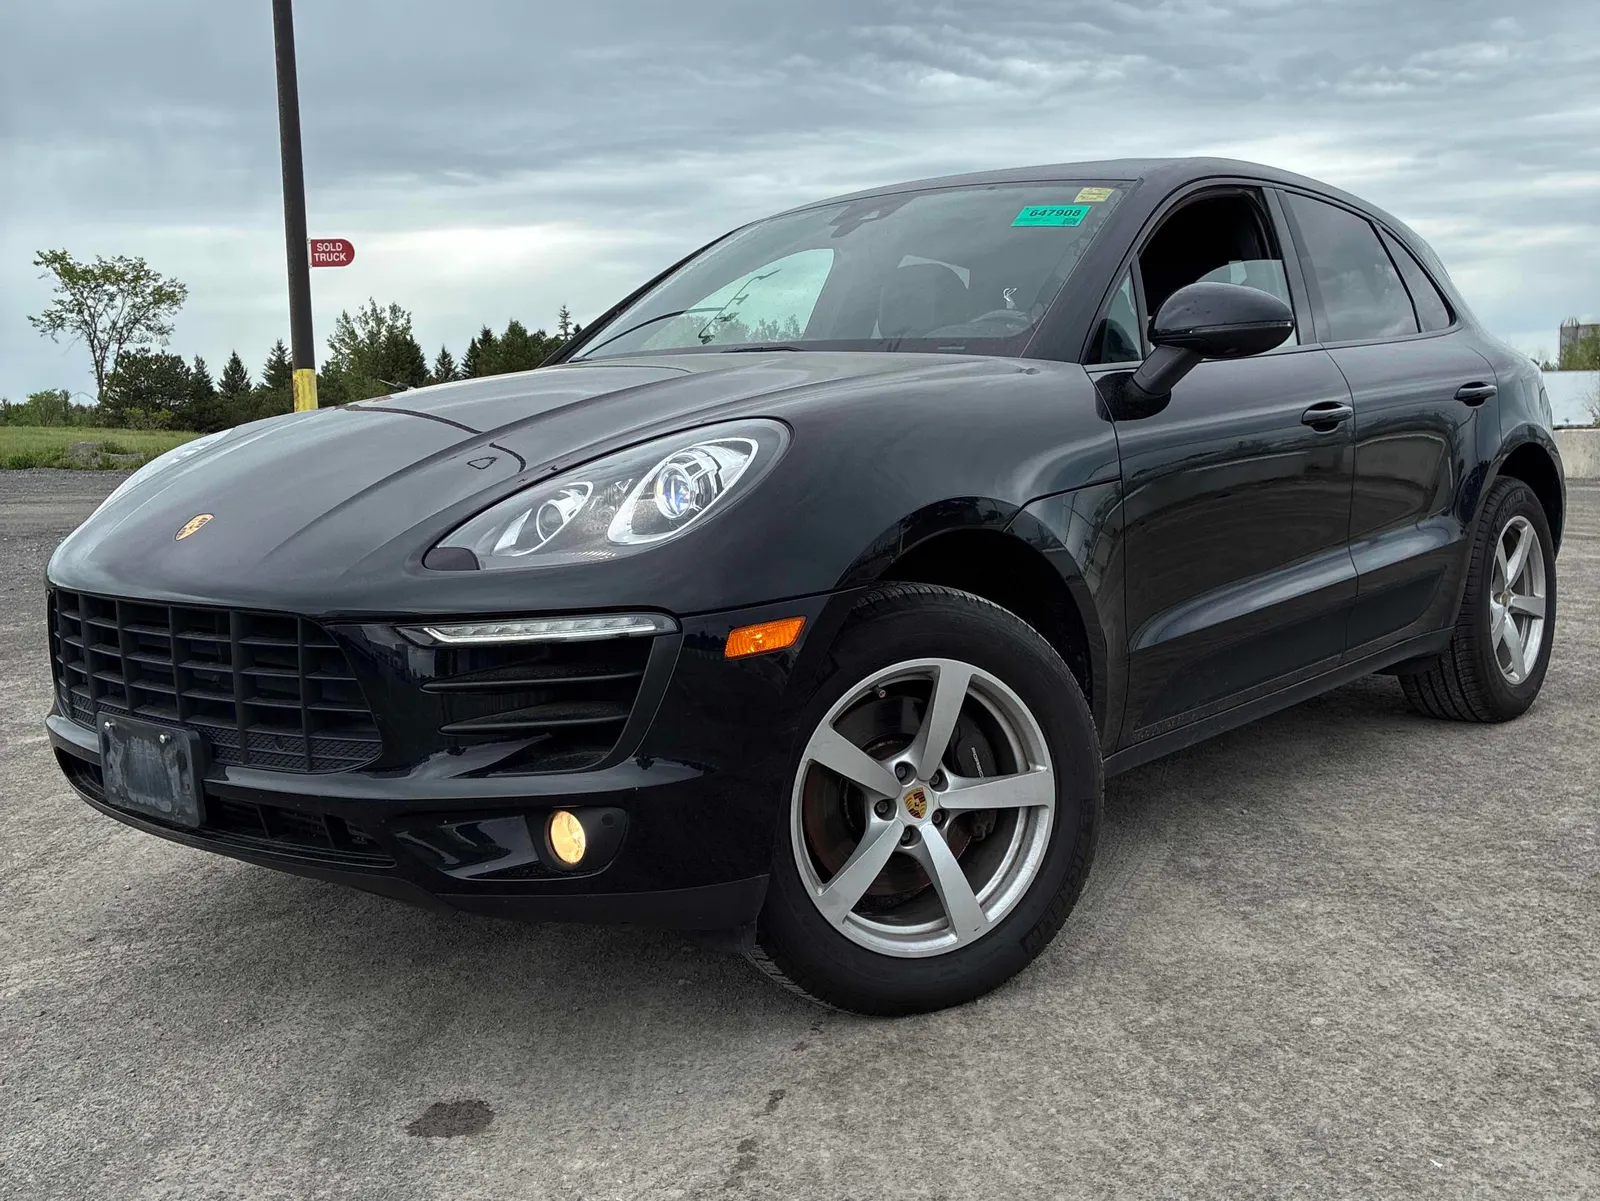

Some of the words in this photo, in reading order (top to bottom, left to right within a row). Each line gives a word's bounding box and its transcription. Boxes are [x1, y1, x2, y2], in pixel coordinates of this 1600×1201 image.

[1029, 209, 1081, 217] 647908
[316, 242, 343, 251] SOLD
[313, 252, 347, 261] TRUCK
